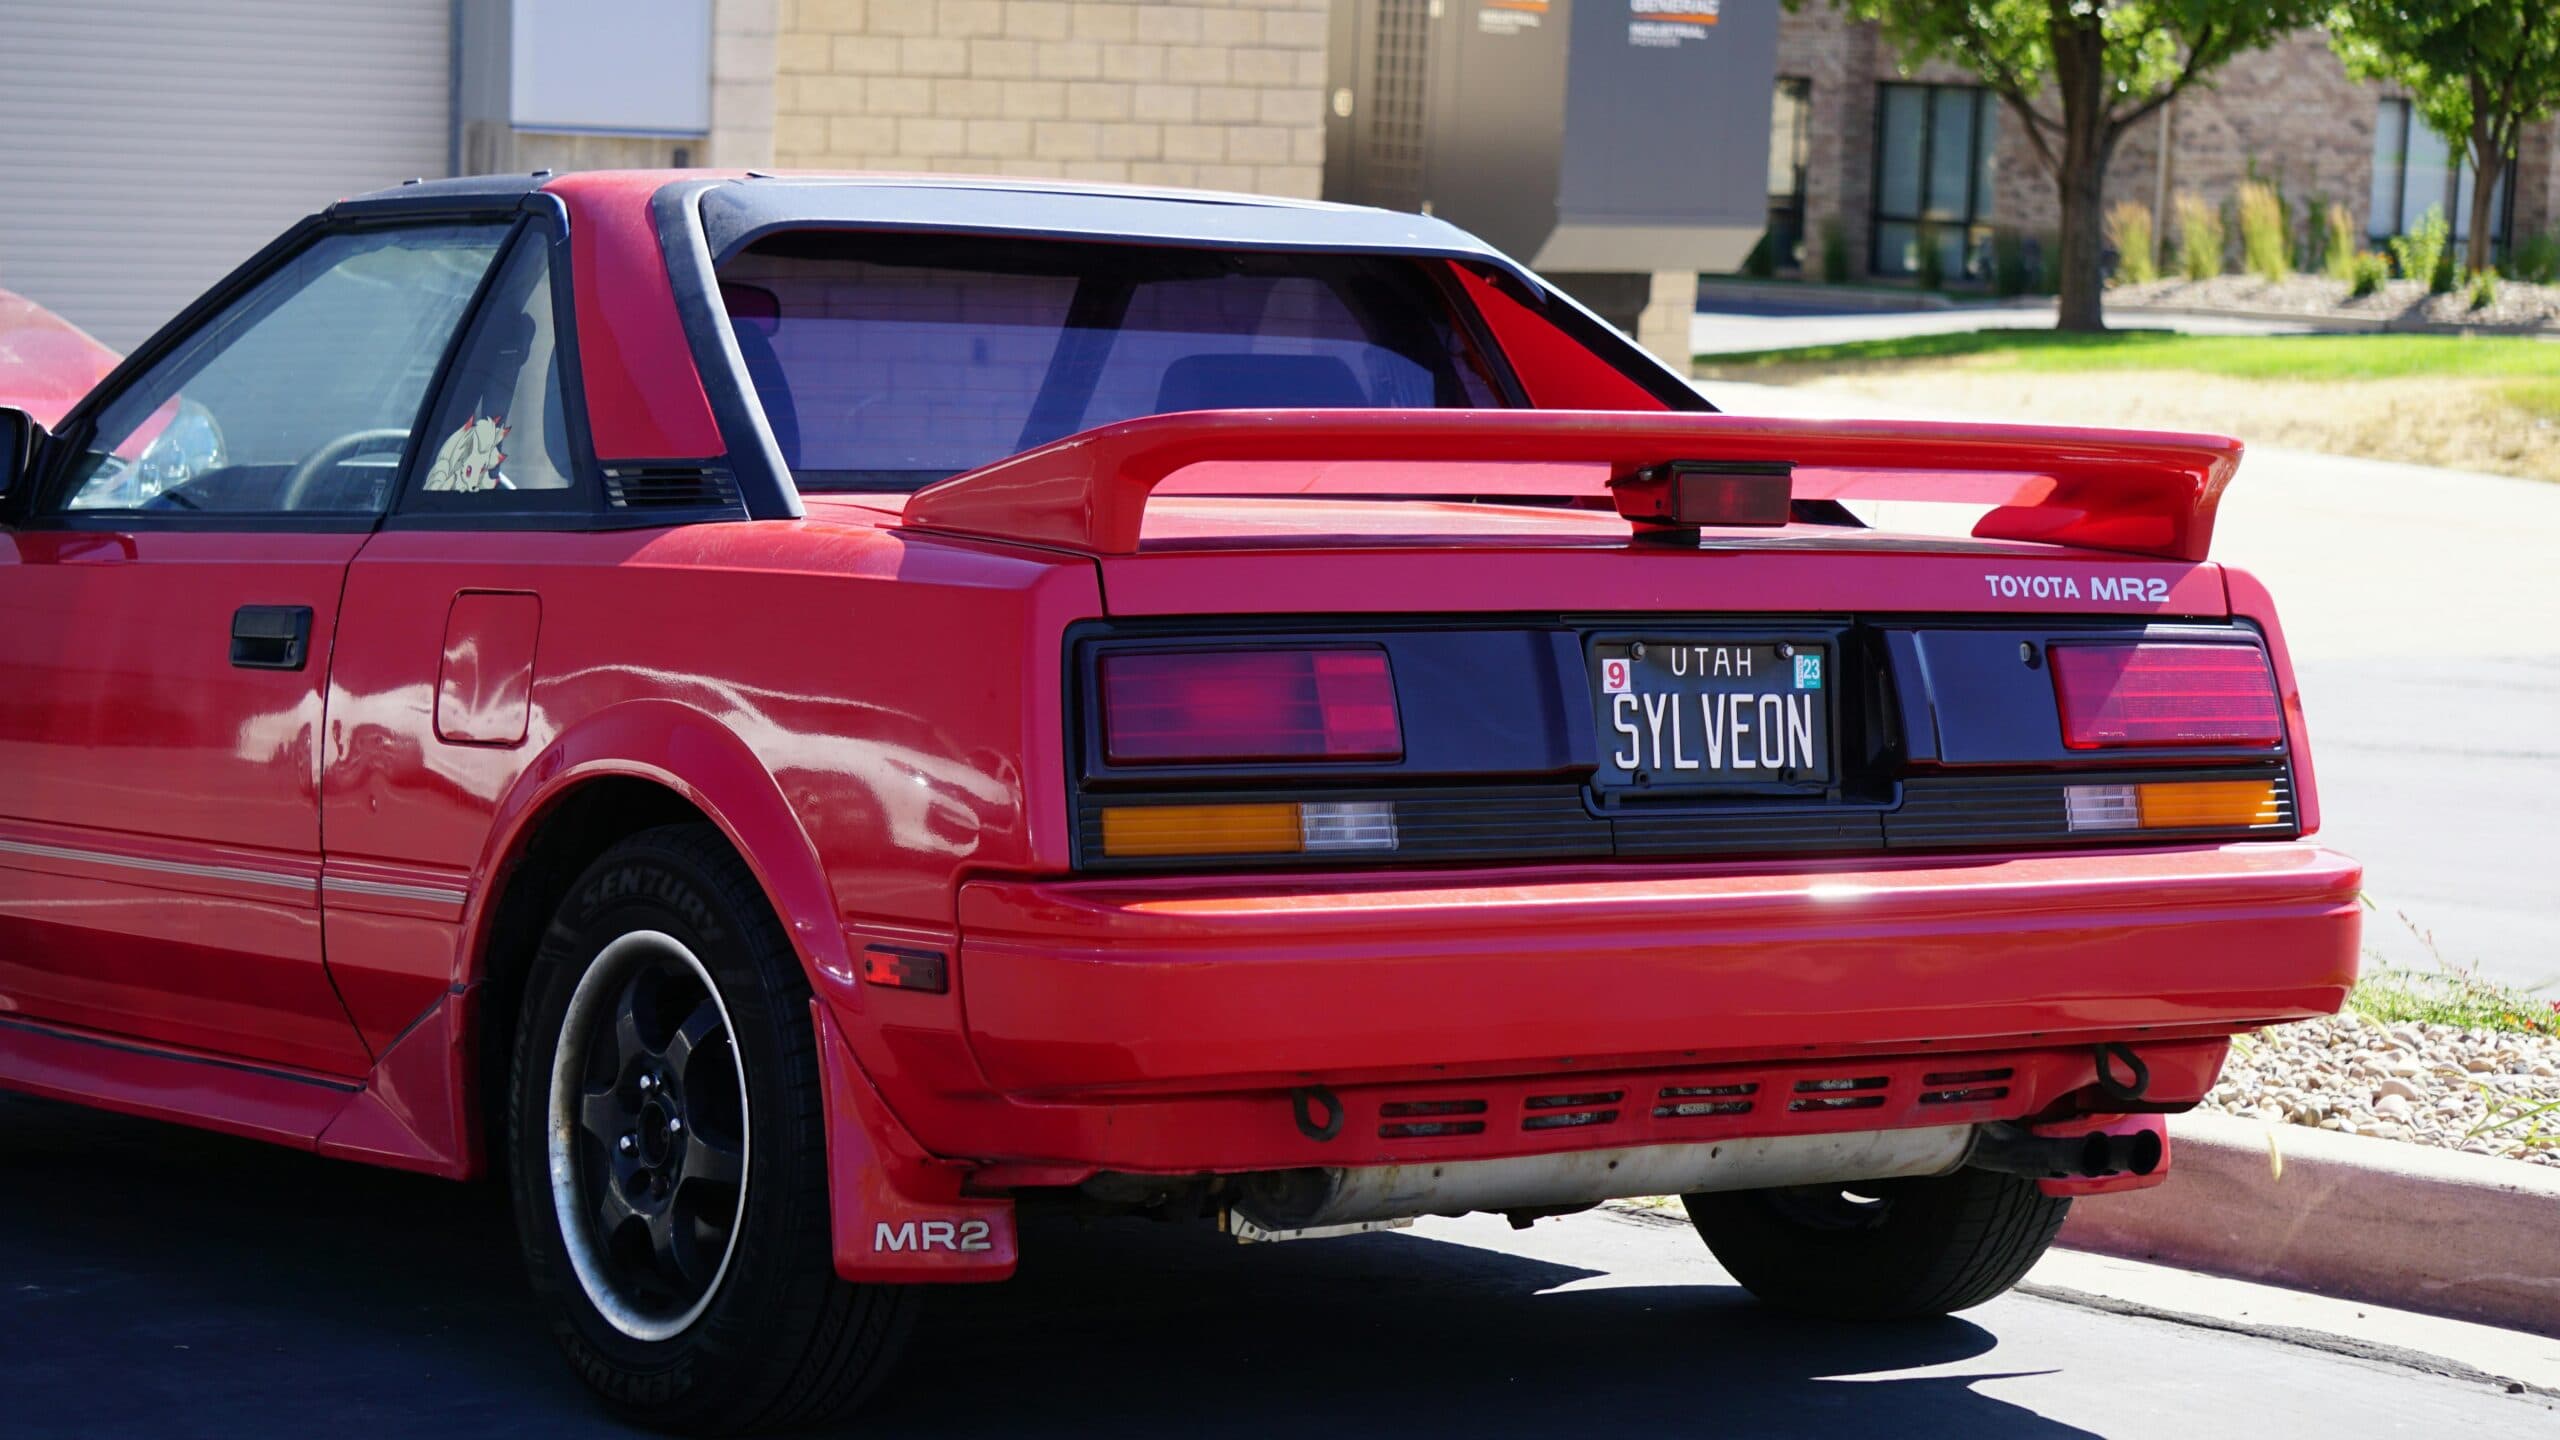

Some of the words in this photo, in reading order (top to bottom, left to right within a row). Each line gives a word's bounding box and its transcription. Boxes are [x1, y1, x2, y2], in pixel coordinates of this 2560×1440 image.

[1985, 575, 2081, 599] TOYOTA
[2090, 577, 2170, 602] MR2
[1607, 662, 1625, 689] 9
[1671, 647, 1752, 677] UTAH
[1803, 658, 1820, 680] 23
[1613, 693, 1814, 769] SYLVEON
[579, 864, 724, 942] SENTURY
[874, 1220, 992, 1252] MR2
